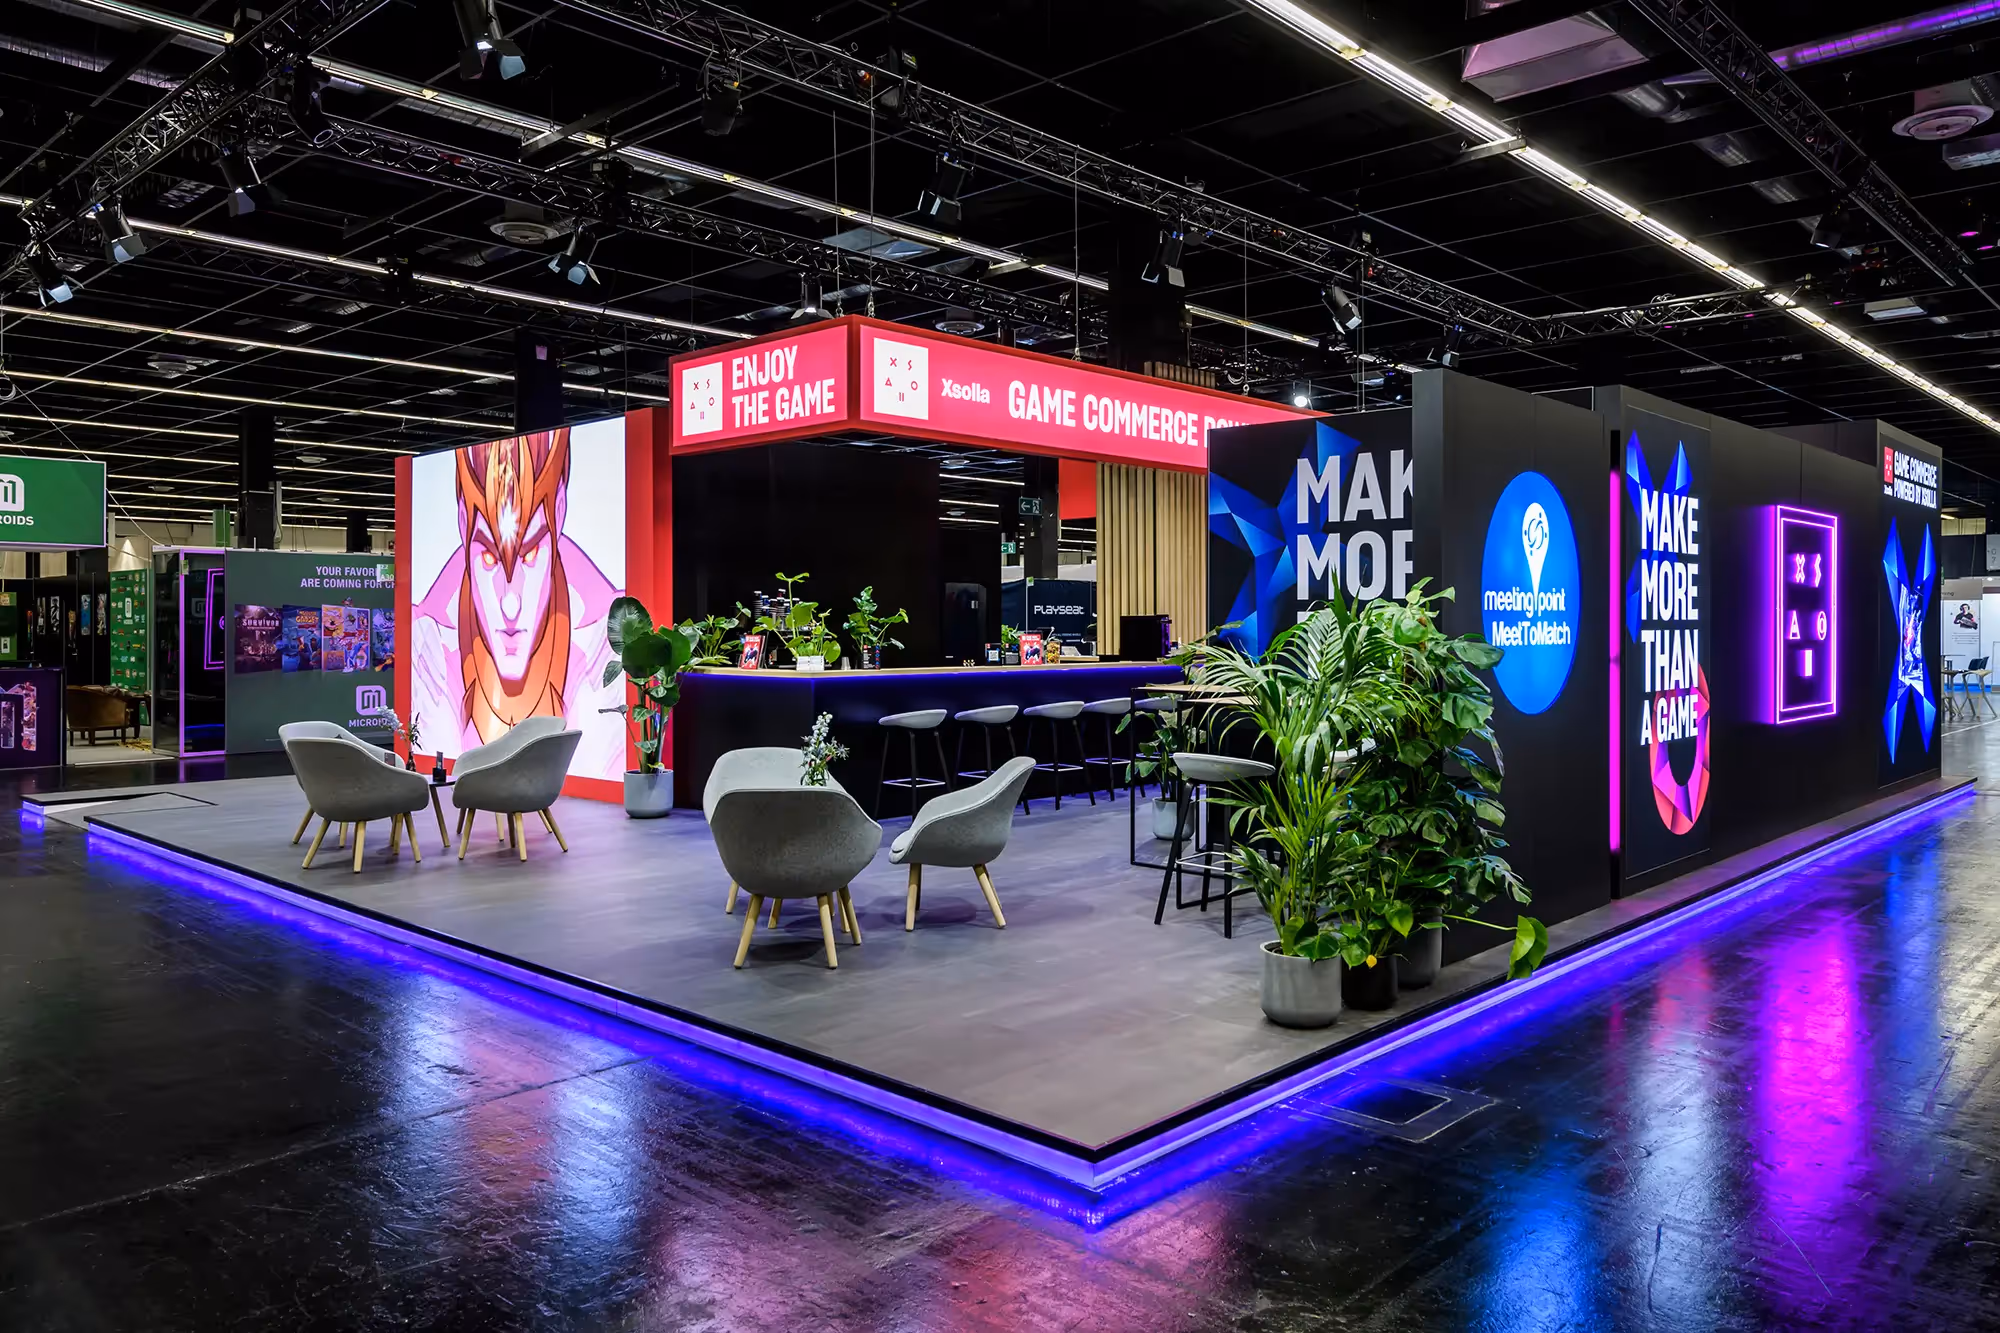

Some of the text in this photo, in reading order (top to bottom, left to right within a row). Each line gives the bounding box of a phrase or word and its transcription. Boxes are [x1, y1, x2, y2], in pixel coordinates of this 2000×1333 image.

[732, 345, 798, 391] ENJOY
[732, 378, 835, 428] THE GAME
[941, 378, 990, 404] Xsolla
[1008, 380, 1076, 428] GAME
[1083, 394, 1198, 446] COMMERCE
[1894, 451, 1937, 488] GAME COMMERCE
[0, 515, 34, 526] OIDS
[1641, 488, 1699, 555] MAKE
[300, 578, 320, 588] ARE
[323, 578, 361, 588] COMING
[364, 579, 382, 588] FOR
[316, 566, 341, 576] YOUR
[1484, 586, 1566, 618] meeting point
[1641, 559, 1699, 621] MORE
[1492, 621, 1571, 646] MeetToMatch
[1641, 629, 1699, 692] THAN
[348, 718, 390, 727] MICROID
[1641, 694, 1699, 746] A GAME
